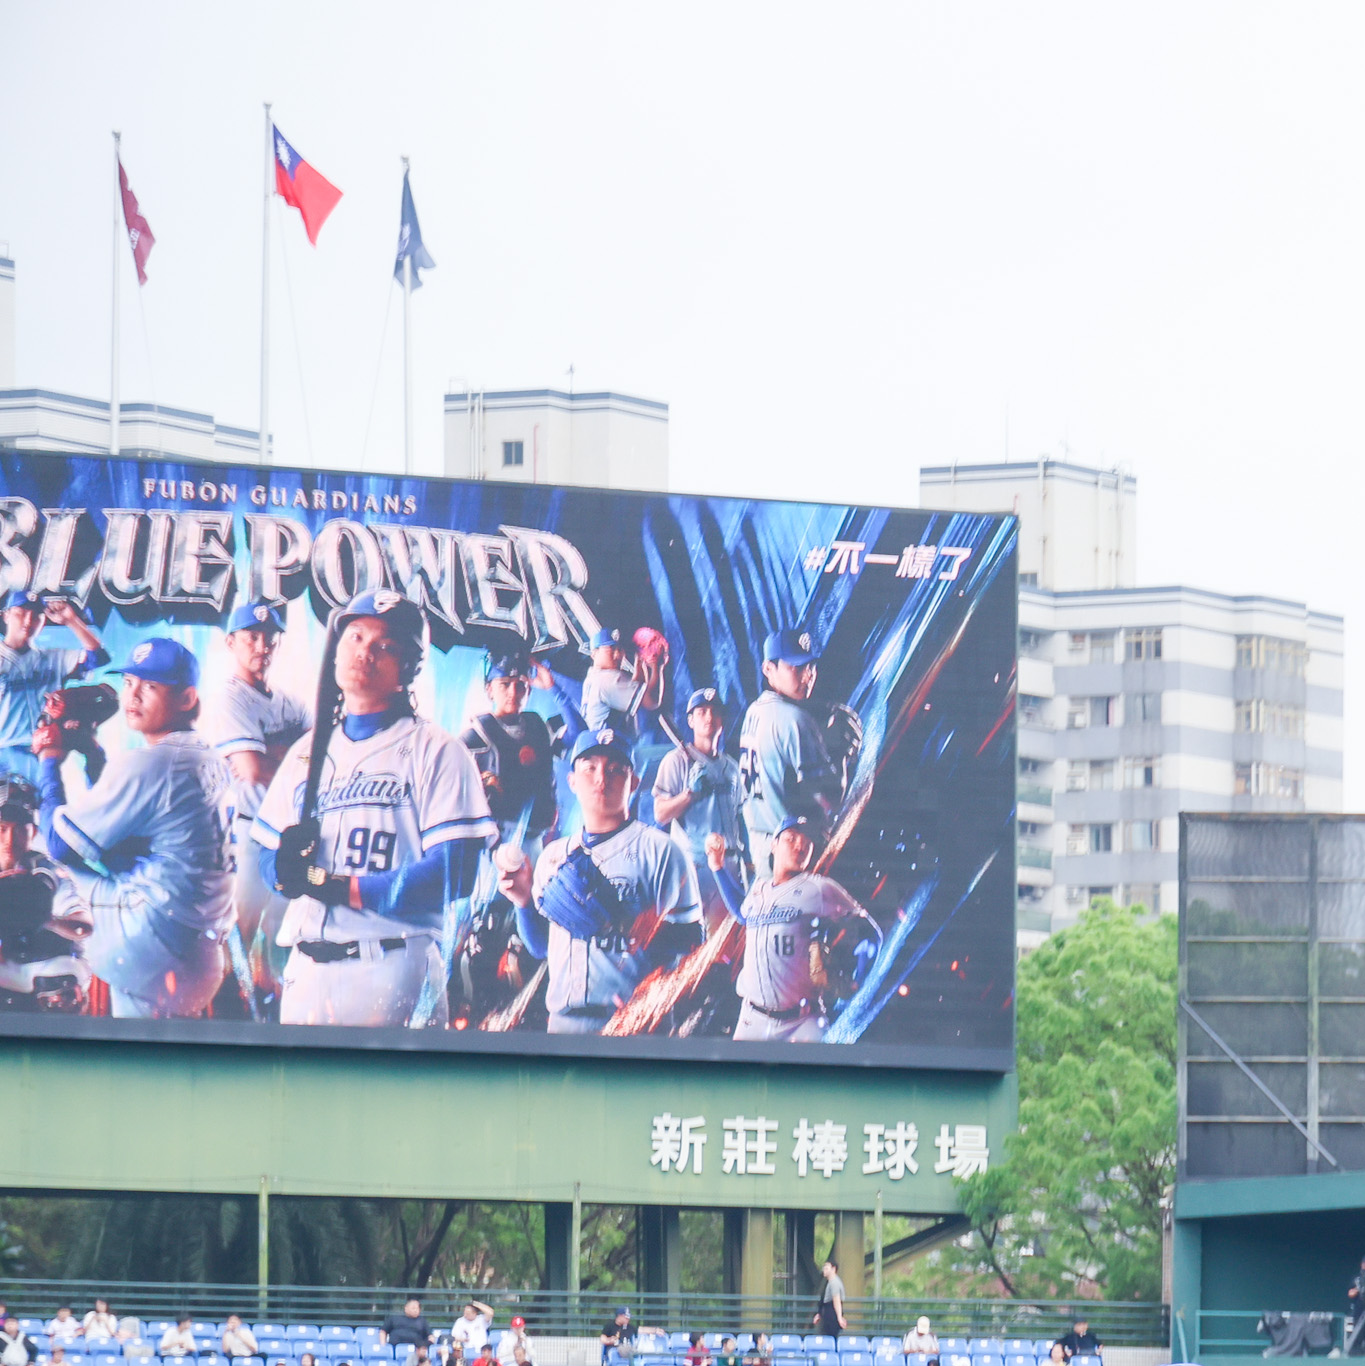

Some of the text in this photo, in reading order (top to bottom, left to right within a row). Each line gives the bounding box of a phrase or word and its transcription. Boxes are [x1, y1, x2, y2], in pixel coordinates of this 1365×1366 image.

[143, 478, 417, 514] FUBON GUARDIANS
[244, 512, 602, 655] POWER
[345, 827, 397, 873] 99
[774, 934, 795, 956] 18
[650, 1112, 990, 1181] 新莊棒球場
